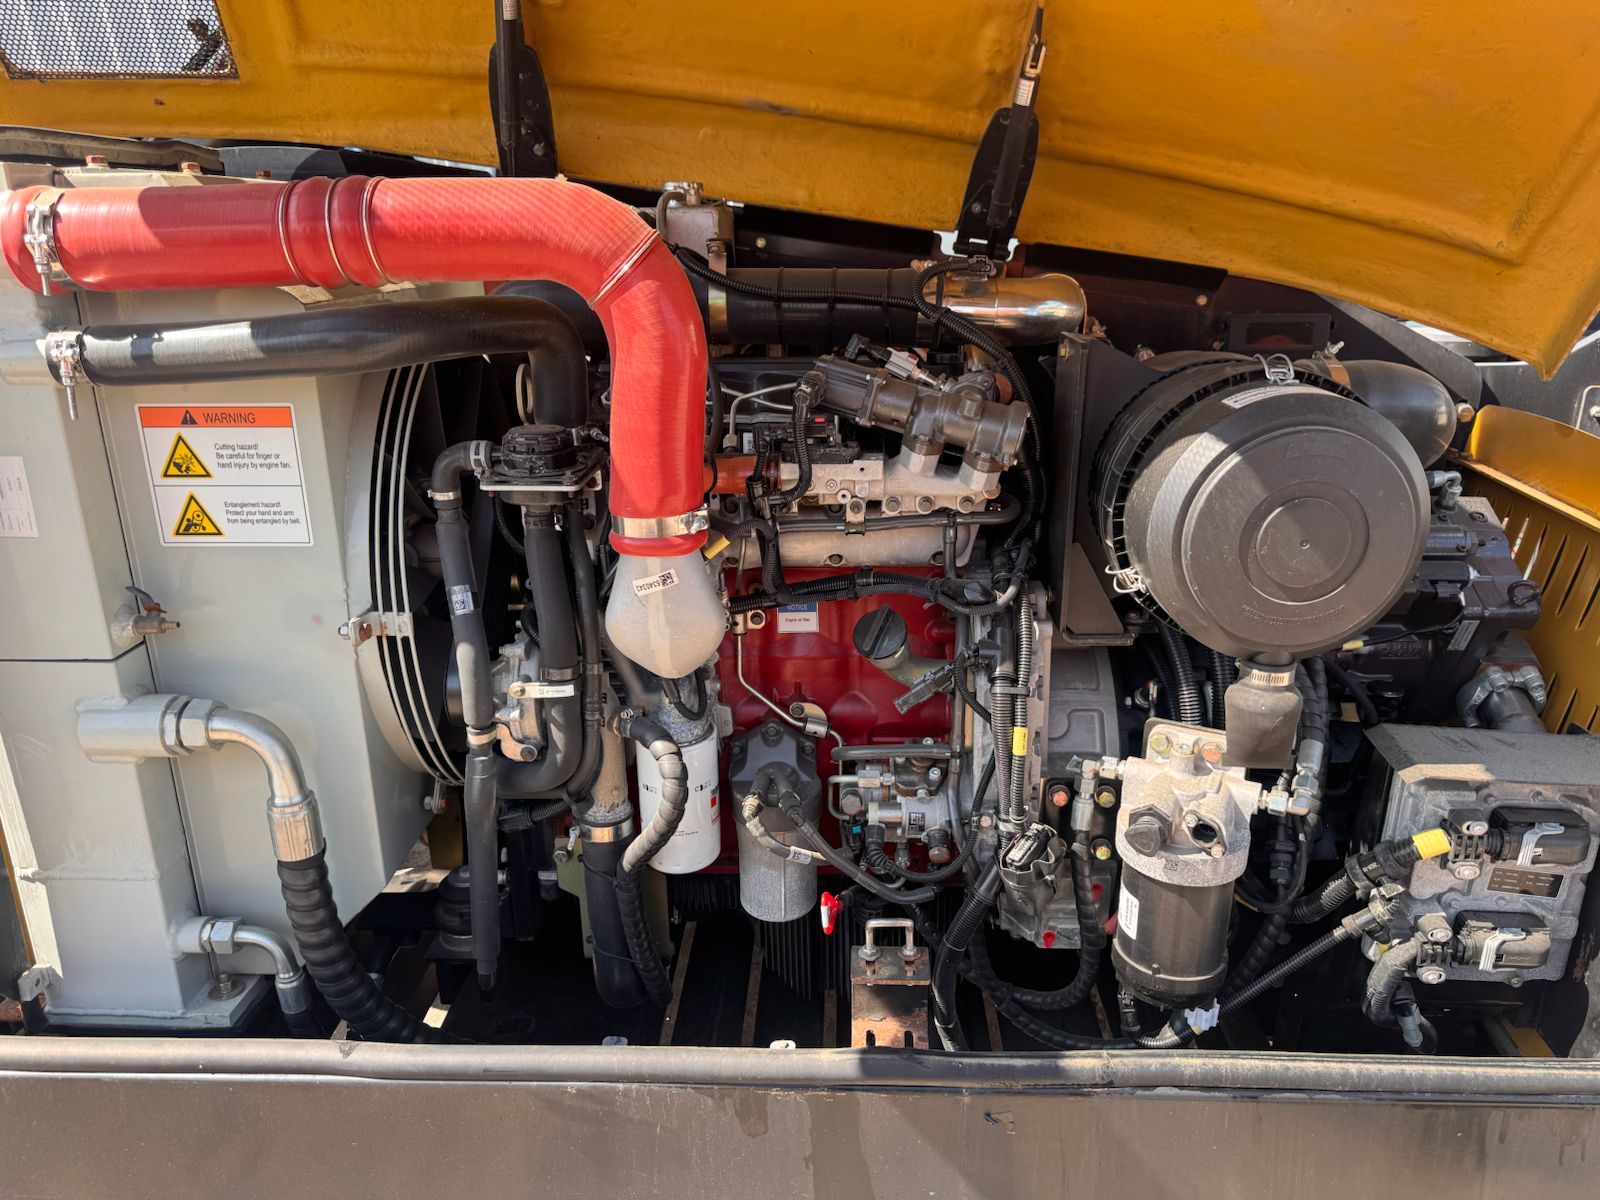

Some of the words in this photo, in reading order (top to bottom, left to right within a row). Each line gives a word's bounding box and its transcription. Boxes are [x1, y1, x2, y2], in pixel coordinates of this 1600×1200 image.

[203, 412, 256, 424] WARNING
[214, 443, 236, 452] Cutting
[236, 443, 259, 451] hazard!
[215, 452, 225, 460] Be
[226, 452, 245, 460] careful
[246, 452, 255, 460] for
[256, 452, 272, 461] finger
[217, 461, 232, 469] hand
[233, 461, 249, 470] injury
[250, 461, 258, 470] by
[259, 461, 279, 470] engine
[280, 461, 291, 469] fan.
[224, 501, 260, 509] Entanglement
[240, 517, 255, 526] being
[255, 517, 281, 526] entangled
[282, 517, 289, 525] by
[786, 603, 808, 611] NOTICE
